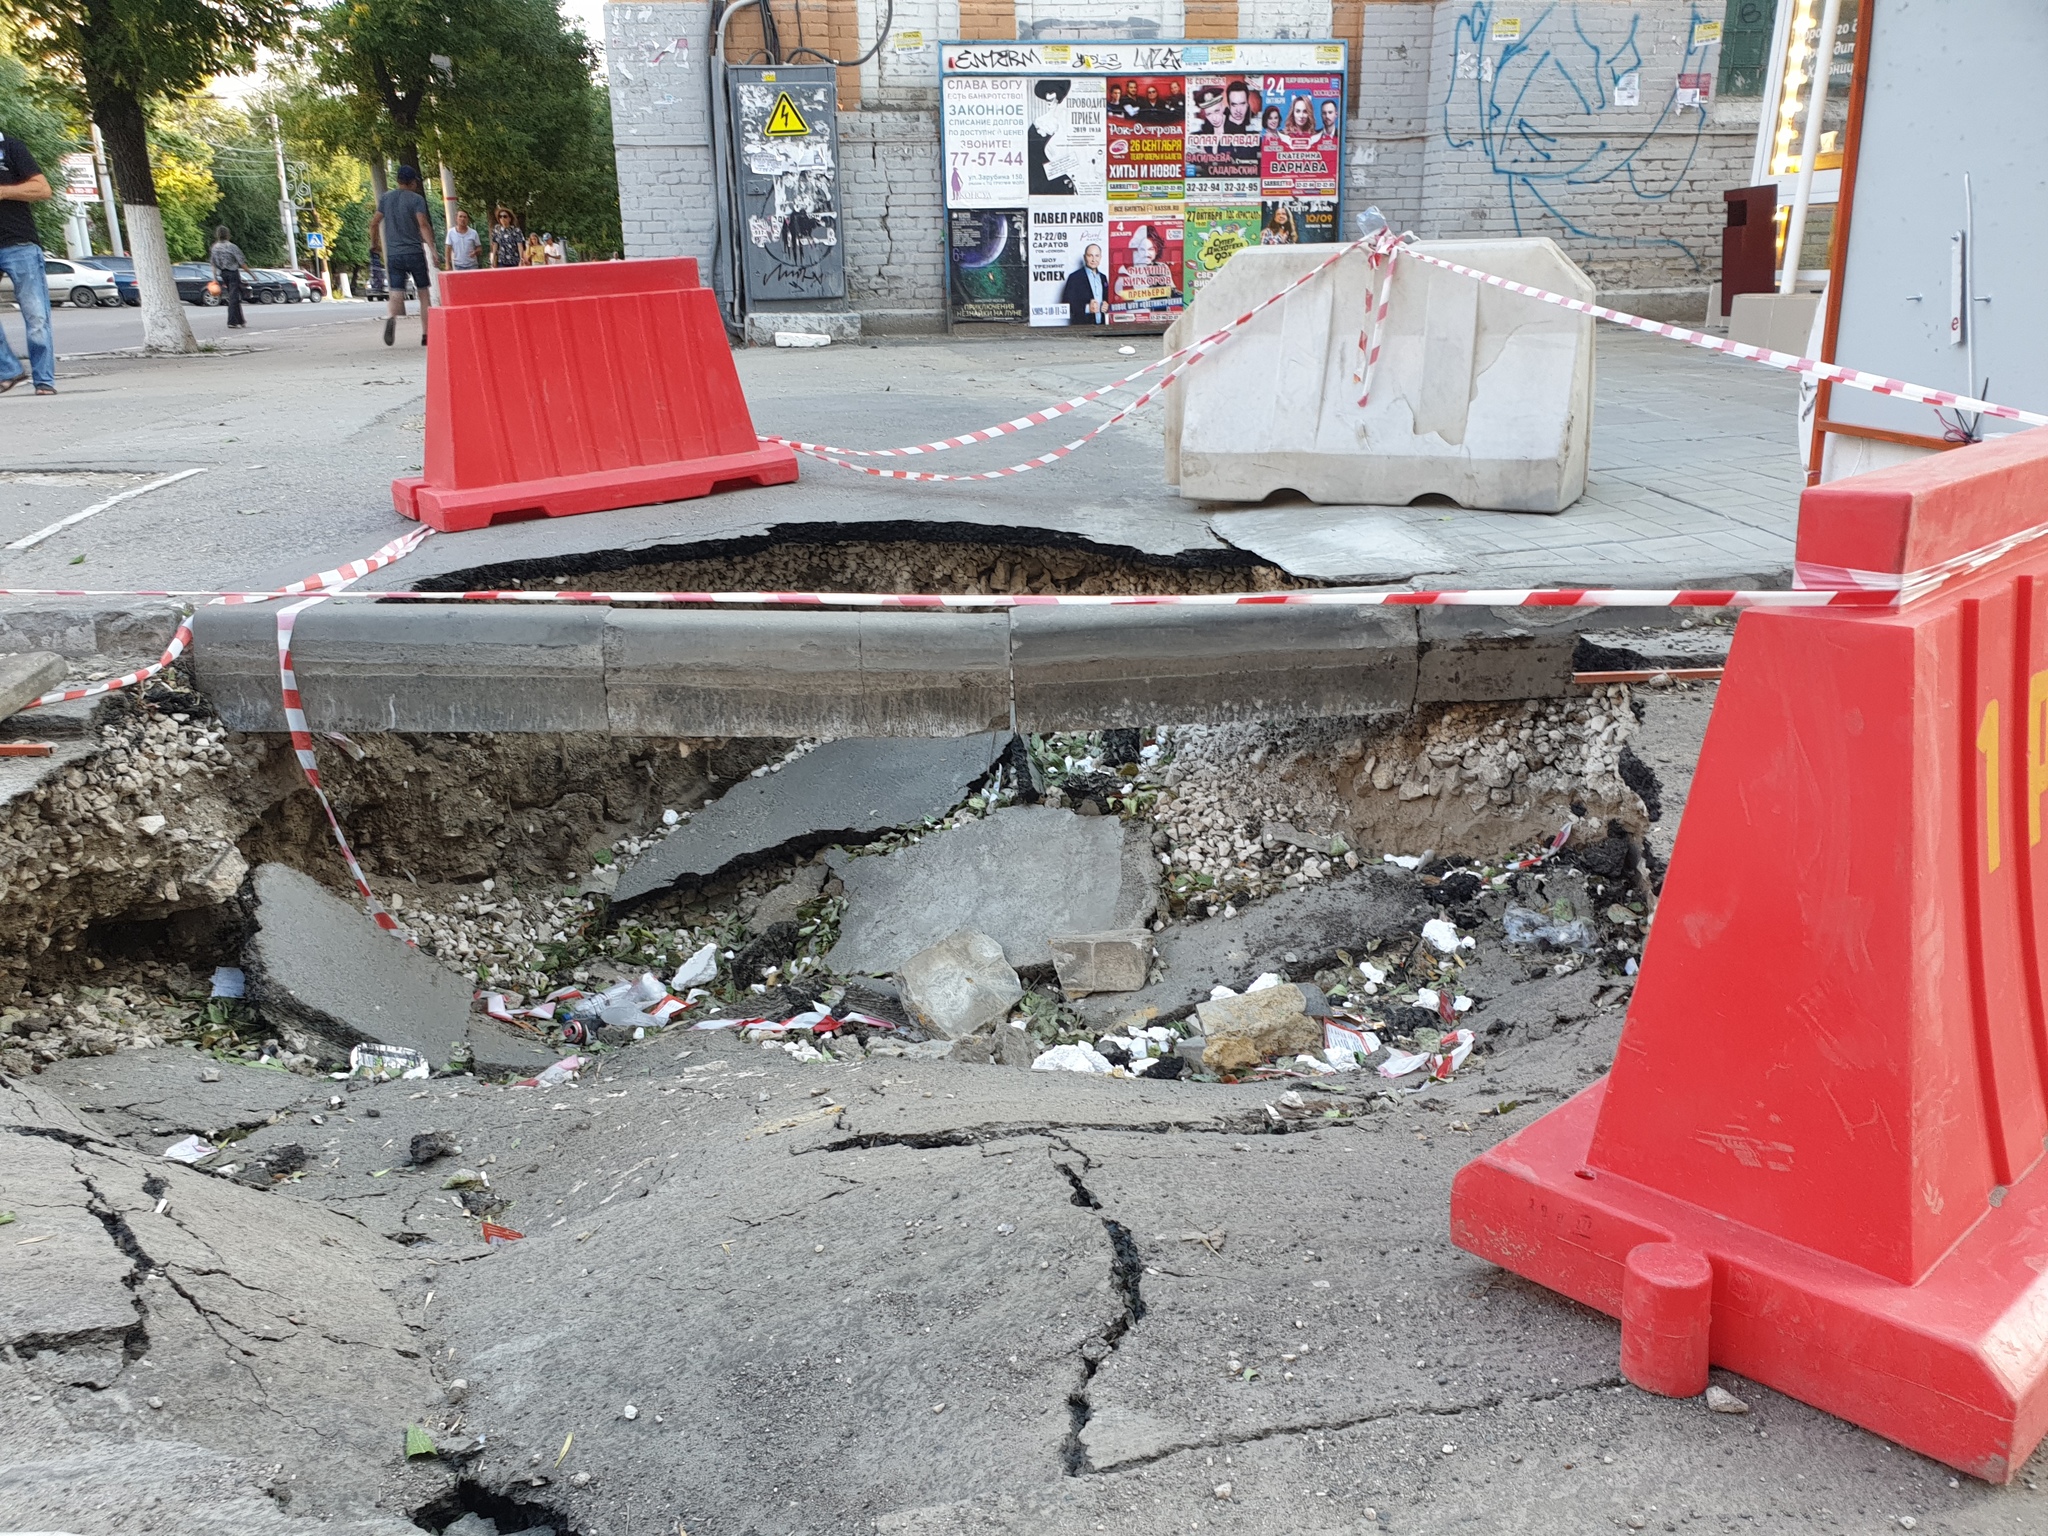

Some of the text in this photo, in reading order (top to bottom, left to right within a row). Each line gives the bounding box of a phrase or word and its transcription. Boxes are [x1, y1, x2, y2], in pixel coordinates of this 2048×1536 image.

[947, 80, 1023, 90] СЛАВА БОГУ
[1266, 77, 1285, 97] 24
[949, 104, 1024, 116] ЗАКОННОЕ
[992, 119, 1024, 127] ДОЛГОВ
[1071, 111, 1101, 125] ПРИЕМ
[960, 140, 1012, 149] ЗВОНИТЕ!
[1129, 139, 1182, 152] 26 СЕНТЯБРЯ
[1187, 135, 1259, 145] ГОЛАЯ ПРАВДА
[950, 151, 1024, 167] 77-57-44
[1186, 152, 1231, 163] ВАСИЛЬЕВА
[1277, 152, 1322, 160] ЕКАТЕРИНА
[1109, 164, 1139, 178] ХИТЫ
[1140, 164, 1148, 178] И
[1149, 164, 1182, 178] НОВОЕ
[1208, 165, 1258, 176] САДАЛЬСКИЙ
[1271, 162, 1327, 172] ВАРНАВА
[1186, 182, 1220, 192] 32-32-94
[1224, 182, 1258, 192] 32-32-95
[1033, 211, 1104, 225] ПАВЕЛ РАКОВ
[1186, 210, 1196, 222] 27
[1196, 211, 1223, 220] ОКТЯБРЯ
[1305, 214, 1333, 223] 10/09
[1116, 221, 1124, 231] 4
[1034, 232, 1068, 241] 21-22/09
[952, 247, 966, 262] 6+
[1033, 271, 1065, 282] УСПЕХ
[1123, 276, 1171, 286] КИРКОРОВ
[1128, 288, 1165, 299] ПРЕМЬЕРА
